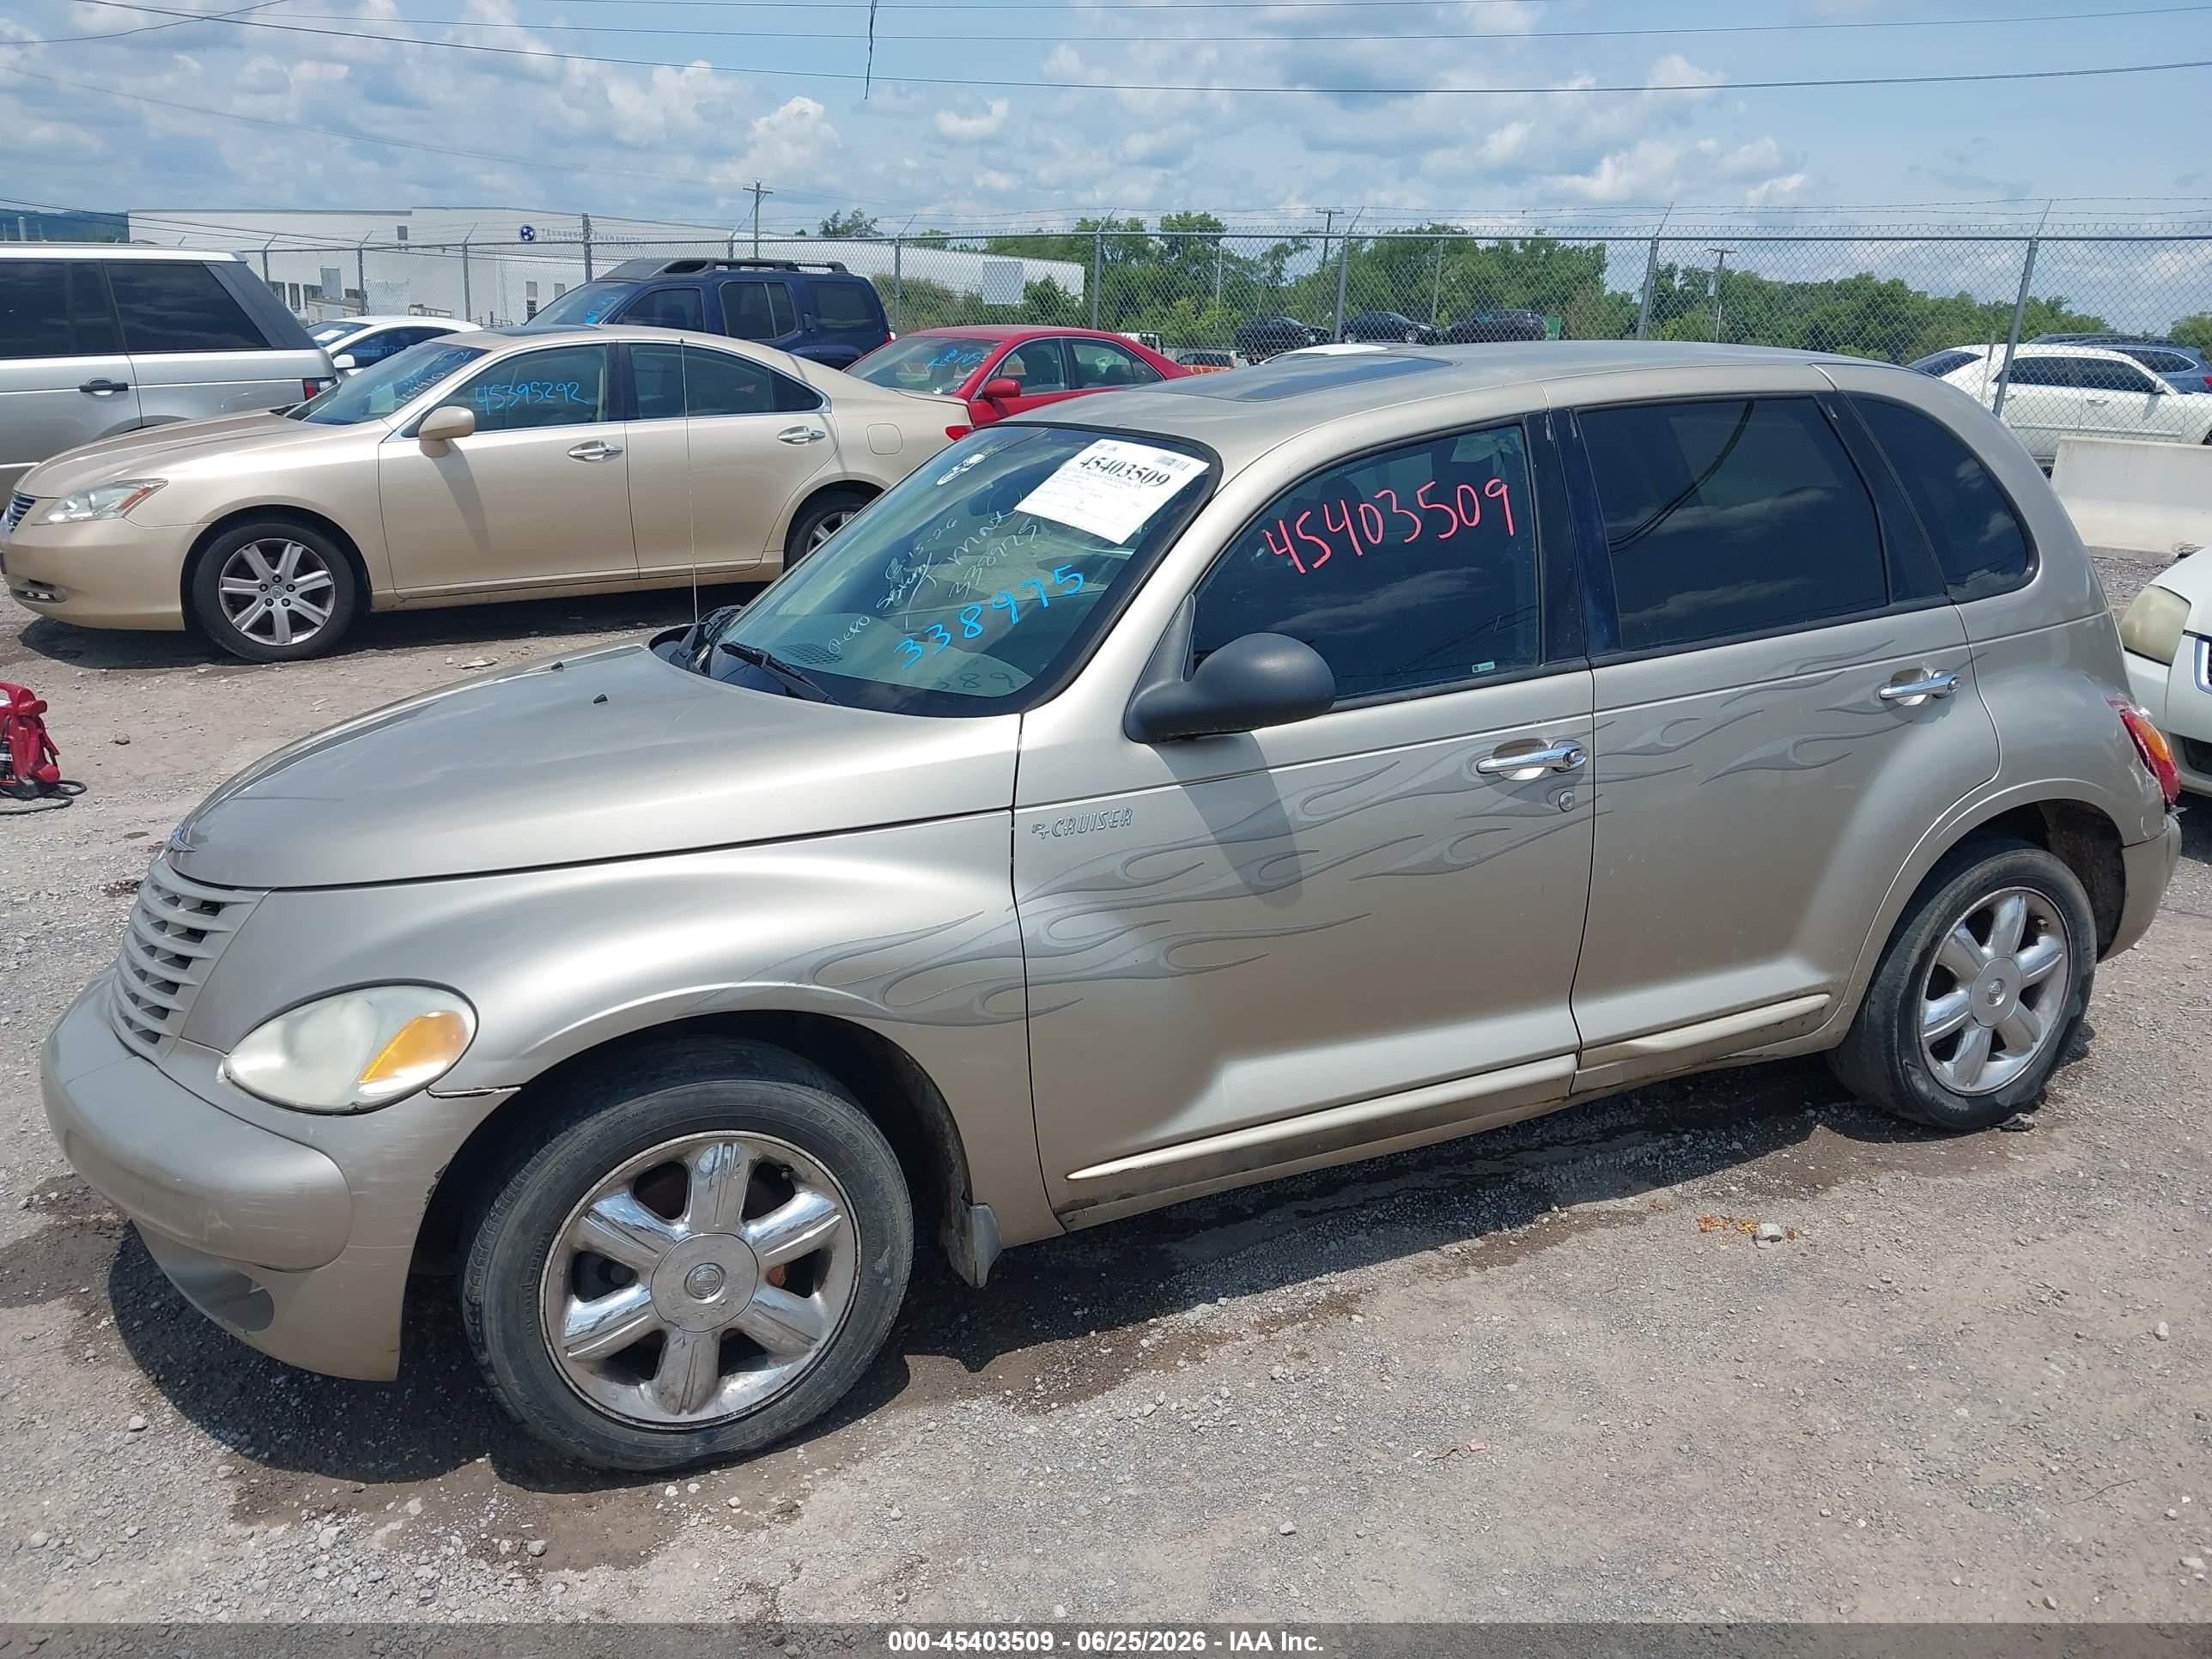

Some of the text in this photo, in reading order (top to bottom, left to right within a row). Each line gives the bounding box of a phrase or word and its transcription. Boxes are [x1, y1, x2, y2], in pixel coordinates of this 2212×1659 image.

[475, 381, 590, 416] 45395292
[1079, 455, 1171, 487] 45403509
[1262, 477, 1516, 574] 45403509
[894, 563, 1085, 671] 338975
[1051, 807, 1133, 837] CRUISER
